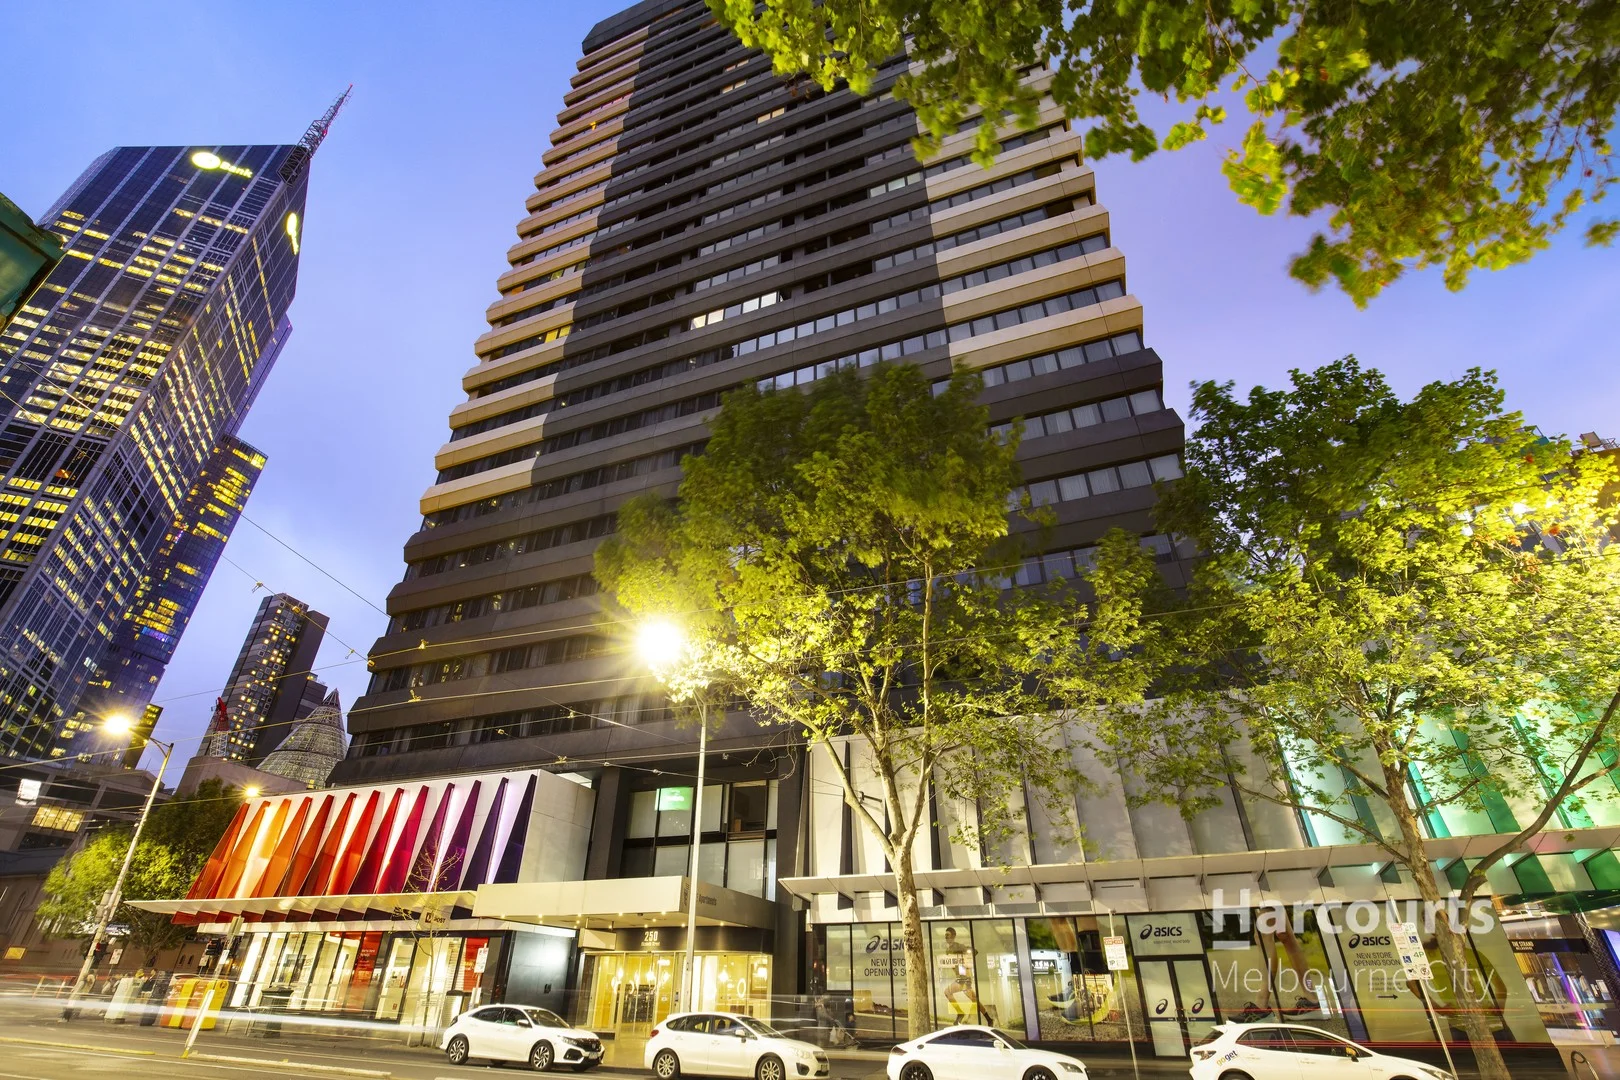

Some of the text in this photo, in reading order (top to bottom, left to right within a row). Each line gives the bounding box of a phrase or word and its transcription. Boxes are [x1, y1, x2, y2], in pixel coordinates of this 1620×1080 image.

[644, 930, 659, 942] 250
[1153, 926, 1182, 937] asics
[1362, 936, 1391, 946] asics
[870, 958, 888, 967] NEW
[1382, 959, 1401, 967] SOON
[864, 968, 899, 977] OPENING
[1216, 1050, 1238, 1066] goget
